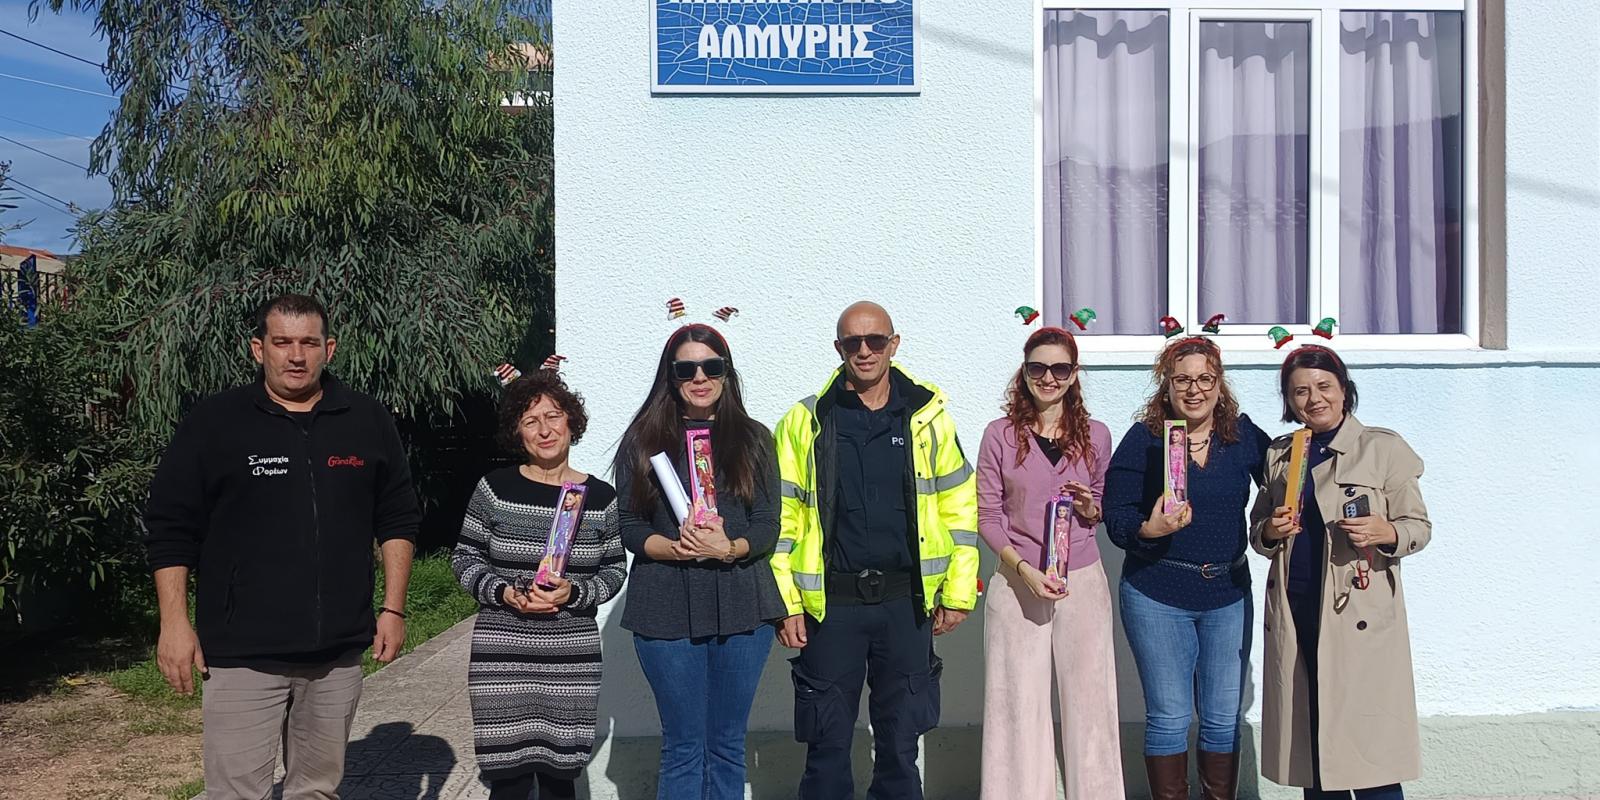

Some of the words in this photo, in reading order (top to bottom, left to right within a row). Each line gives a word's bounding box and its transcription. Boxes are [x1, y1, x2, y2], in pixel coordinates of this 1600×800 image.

[698, 24, 874, 59] ΑΛΜΥΡΗΣ
[248, 455, 289, 465] Συμμαχία
[252, 466, 288, 476] Φορέων
